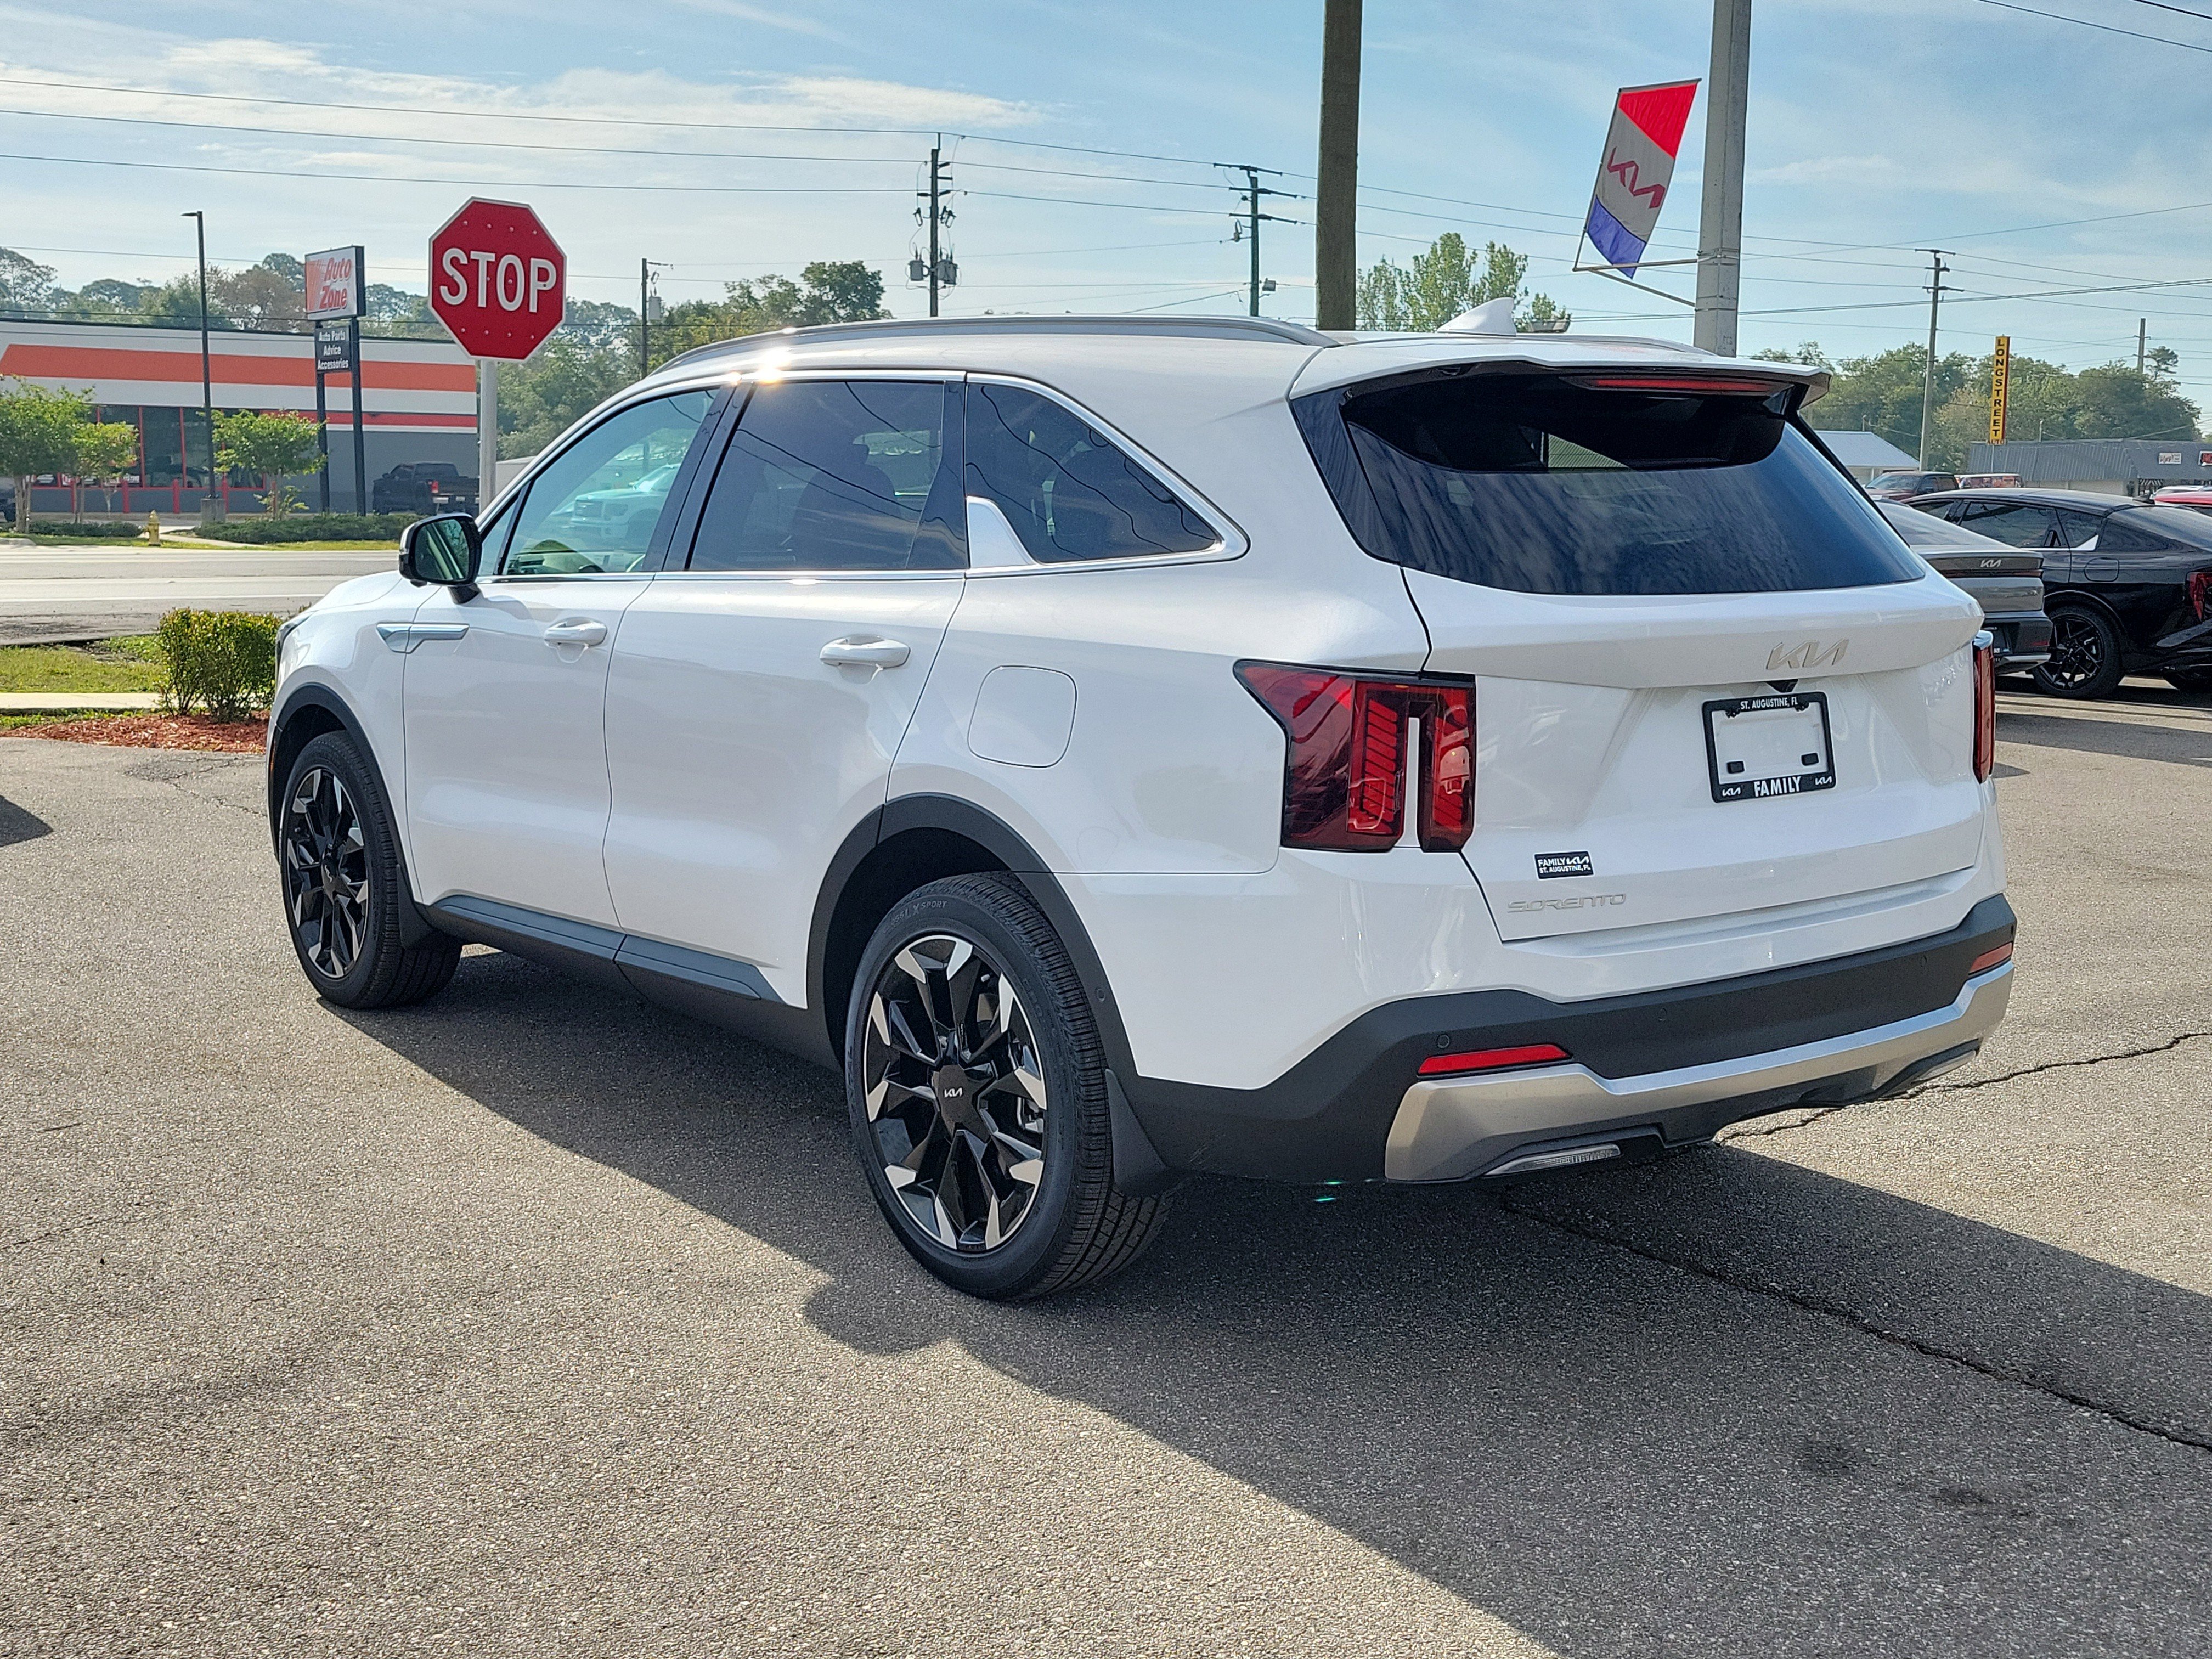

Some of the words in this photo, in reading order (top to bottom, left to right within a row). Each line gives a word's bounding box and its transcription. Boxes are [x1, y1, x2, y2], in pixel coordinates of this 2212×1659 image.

[324, 257, 352, 281] Auto
[439, 247, 557, 313] STOP
[319, 285, 347, 311] Zone
[318, 332, 331, 342] Auto
[331, 330, 346, 341] Parts
[323, 345, 341, 356] Advice
[317, 358, 349, 370] Accessories
[1992, 338, 2005, 437] LONGSTREET
[1766, 639, 1849, 670] KIA
[1740, 701, 1750, 710] ST.
[1752, 697, 1790, 709] AUGUSTINE,
[1791, 696, 1798, 706] FL
[1722, 787, 1741, 796] KIA
[1753, 776, 1802, 797] FAMILY
[1815, 776, 1832, 785] KIA
[1538, 857, 1565, 867] FAMILY
[1566, 856, 1589, 865] KIA
[1549, 865, 1584, 873] AUGUSTINE,
[921, 900, 947, 909] SPORT
[1508, 893, 1626, 913] SORENTO
[944, 1087, 962, 1098] KIA
